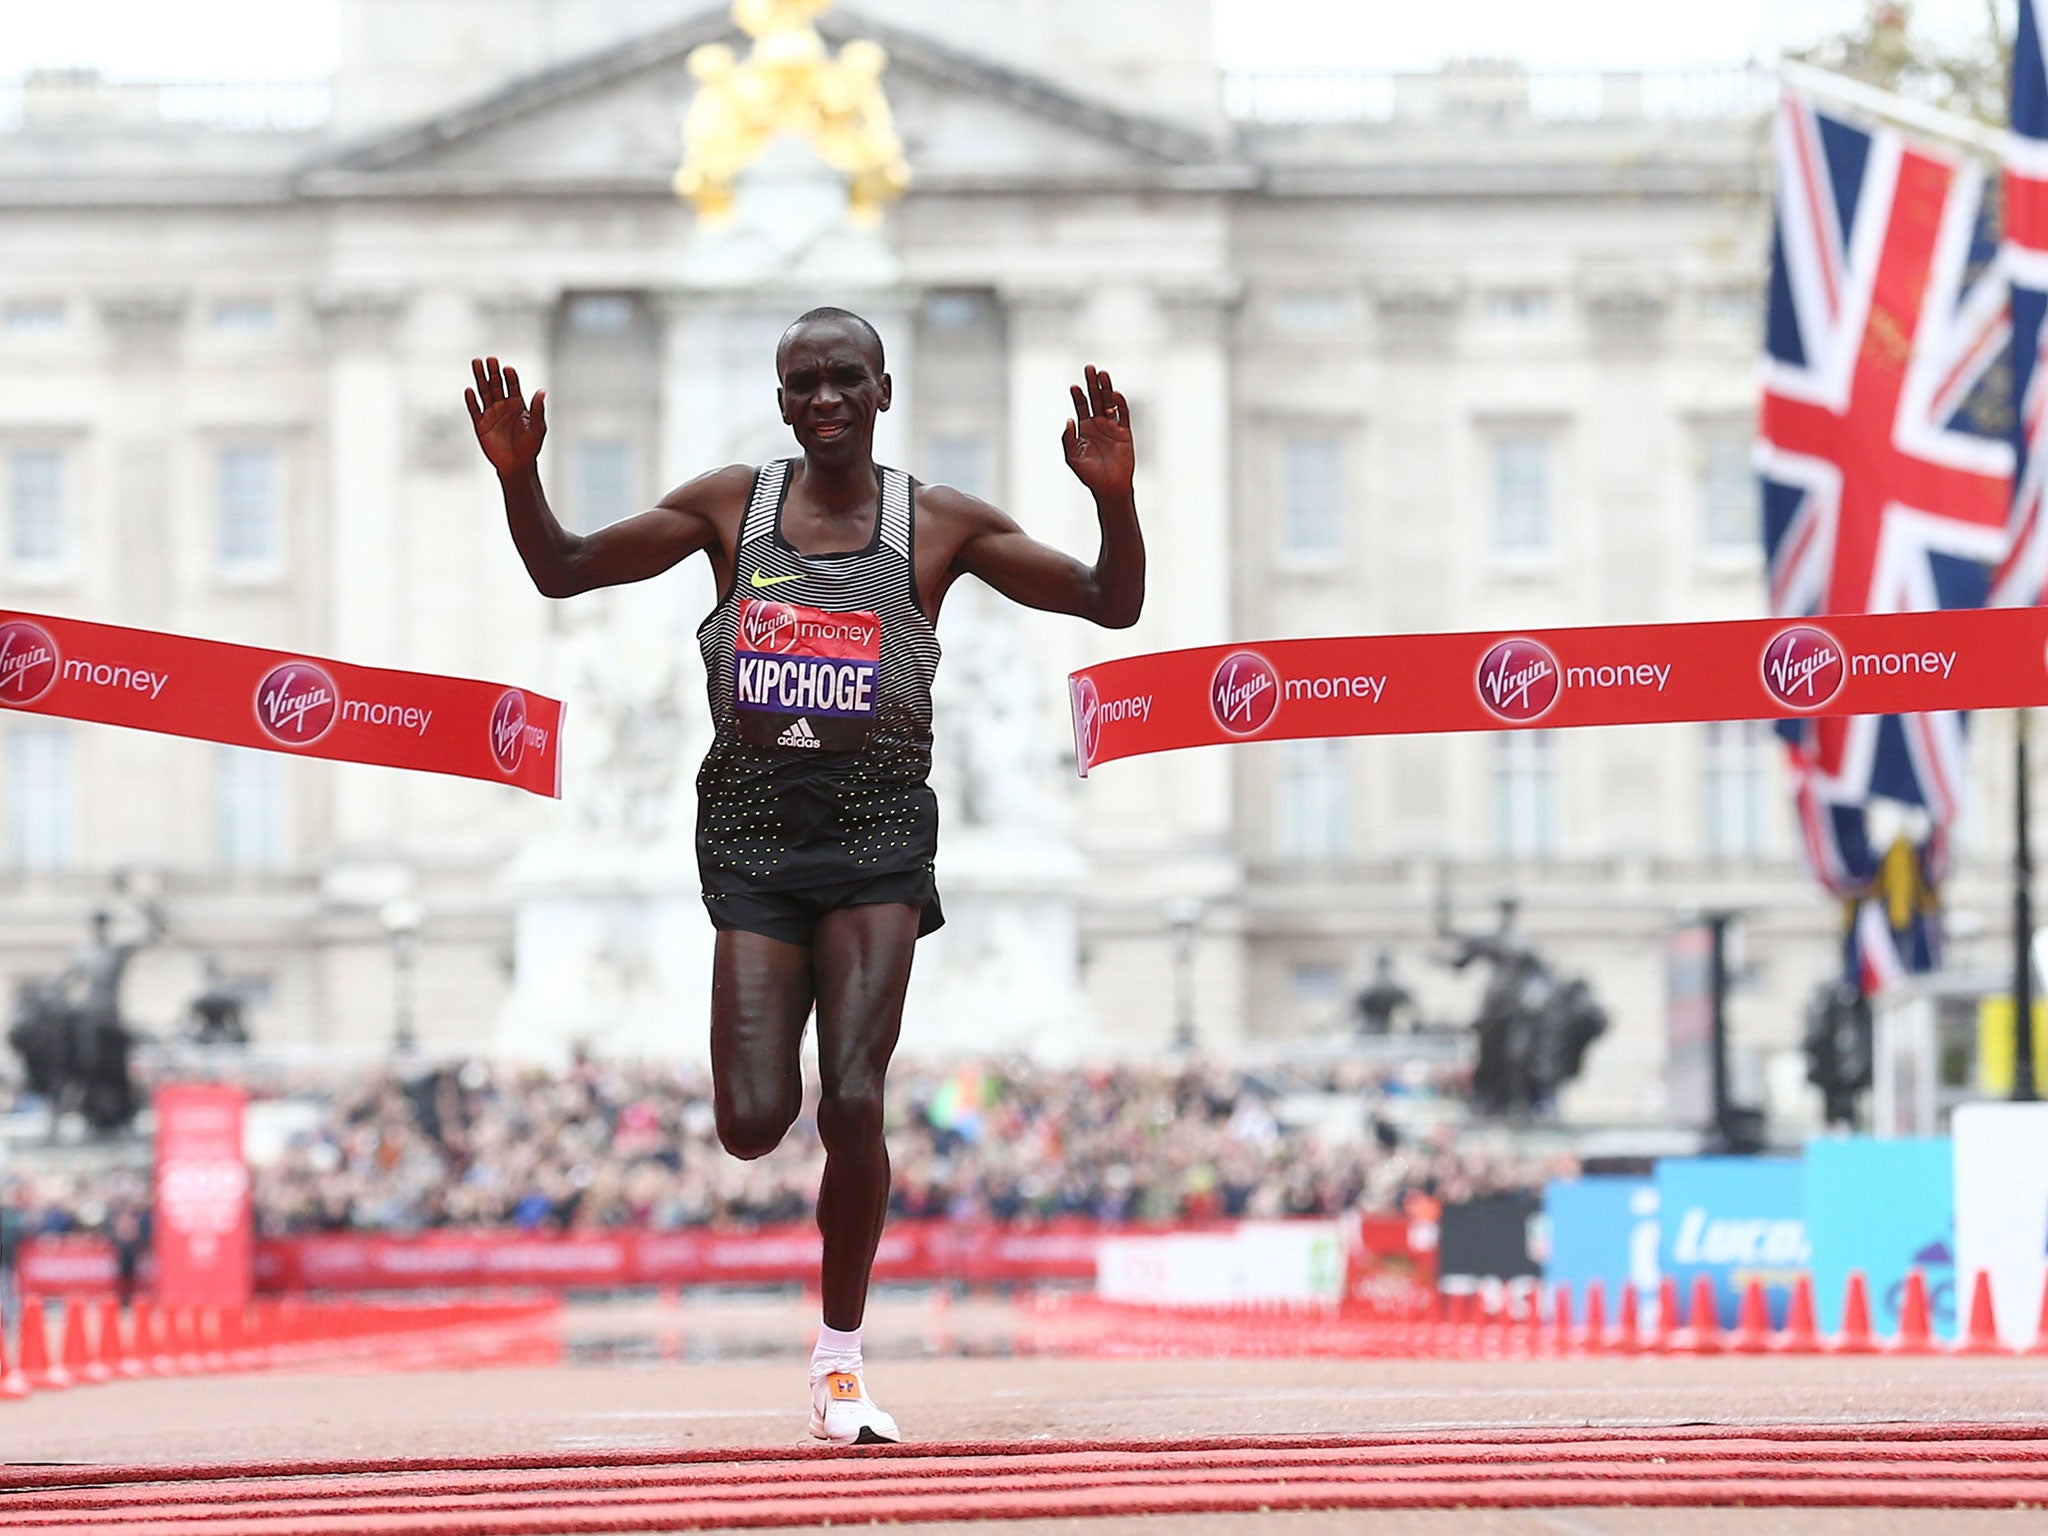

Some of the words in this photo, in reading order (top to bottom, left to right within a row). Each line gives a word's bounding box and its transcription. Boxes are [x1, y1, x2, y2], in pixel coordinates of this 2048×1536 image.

[745, 600, 793, 649] Virgin
[801, 622, 874, 646] money
[63, 659, 169, 700] money
[738, 657, 874, 711] KIPCHOGE
[1217, 663, 1272, 722] Virgin
[1284, 675, 1387, 704] money
[1485, 650, 1552, 710] Virgin
[1566, 663, 1671, 692] money
[1771, 637, 1837, 697] Virgin
[1851, 651, 1957, 680] money
[264, 672, 331, 733] Virgin
[342, 700, 432, 736] money
[1100, 694, 1153, 723] money
[777, 735, 821, 749] adidas
